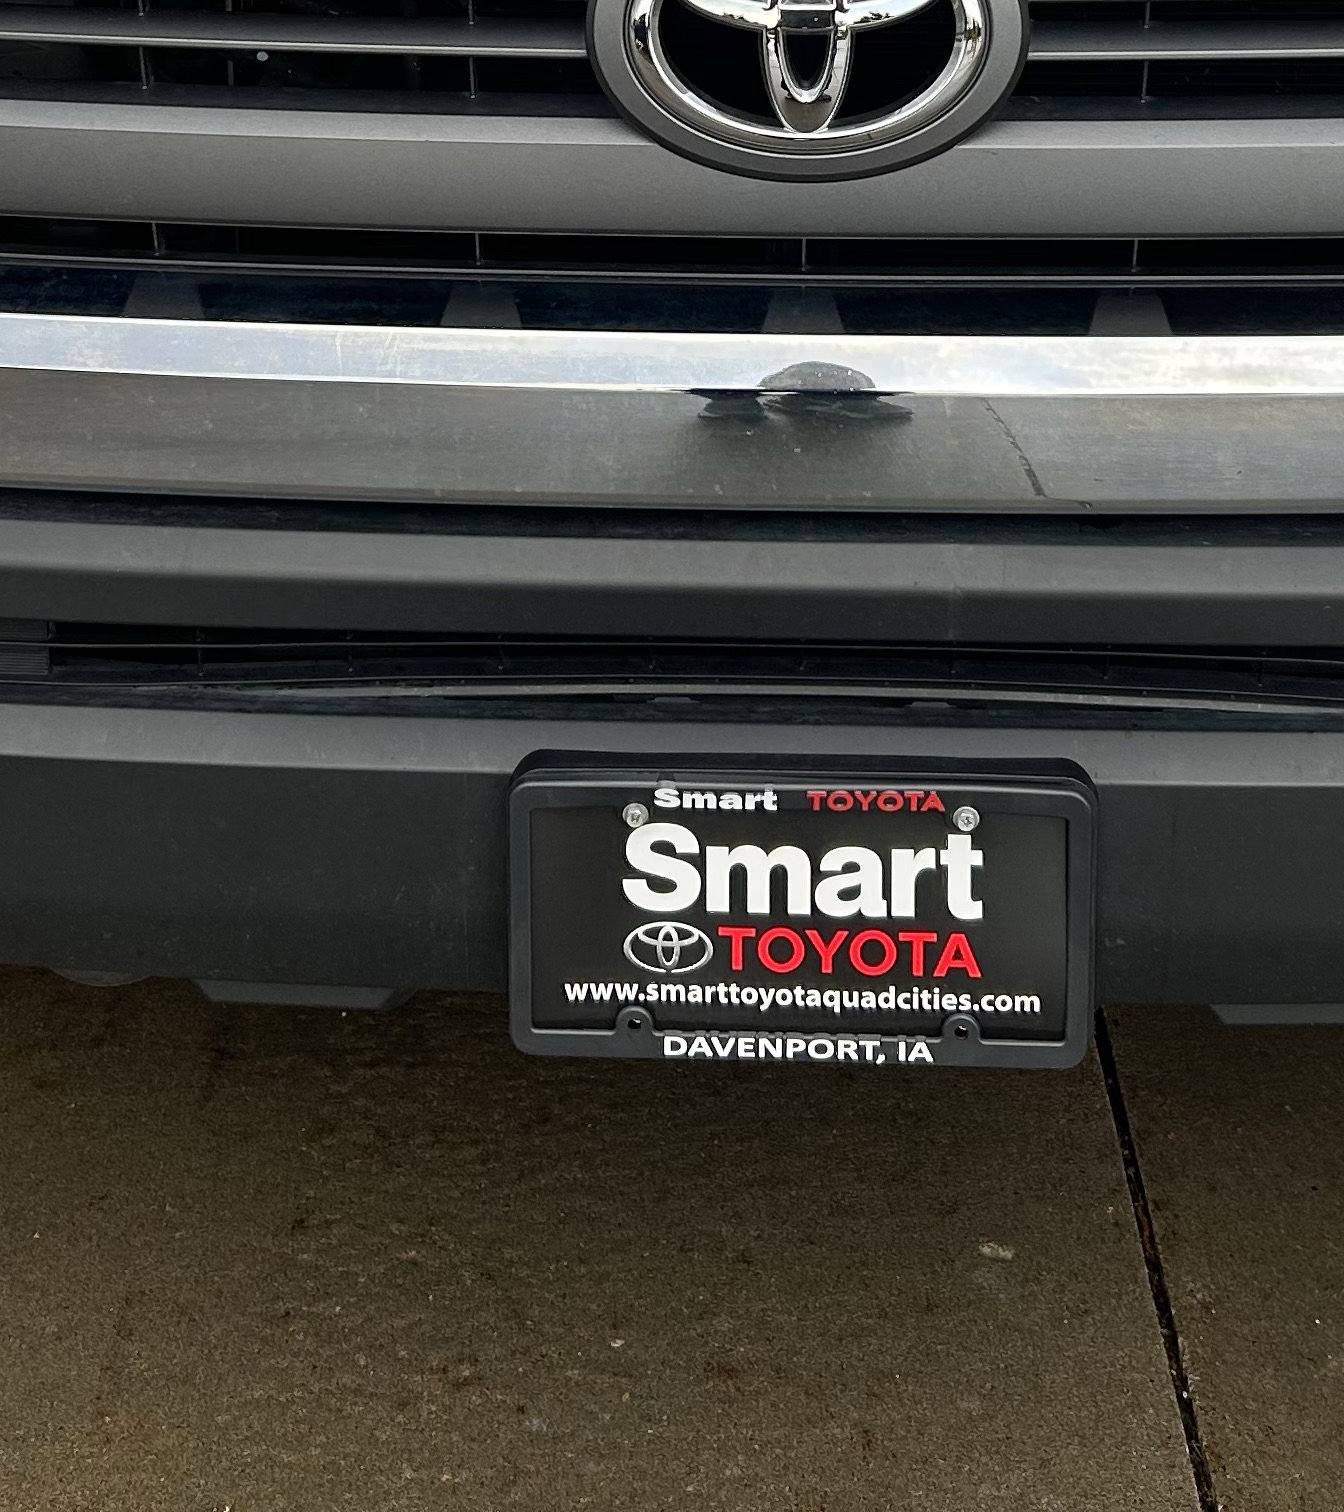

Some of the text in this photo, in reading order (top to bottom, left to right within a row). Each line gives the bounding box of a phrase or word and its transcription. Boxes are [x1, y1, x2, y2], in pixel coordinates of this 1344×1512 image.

[653, 788, 946, 813] Smart TOYOTA
[622, 822, 984, 920] Smart
[717, 925, 982, 979] TOYOTA
[564, 981, 1042, 1014] www.smarttoyotaquadcities.com
[663, 1035, 934, 1064] DAVENPORT, IA
